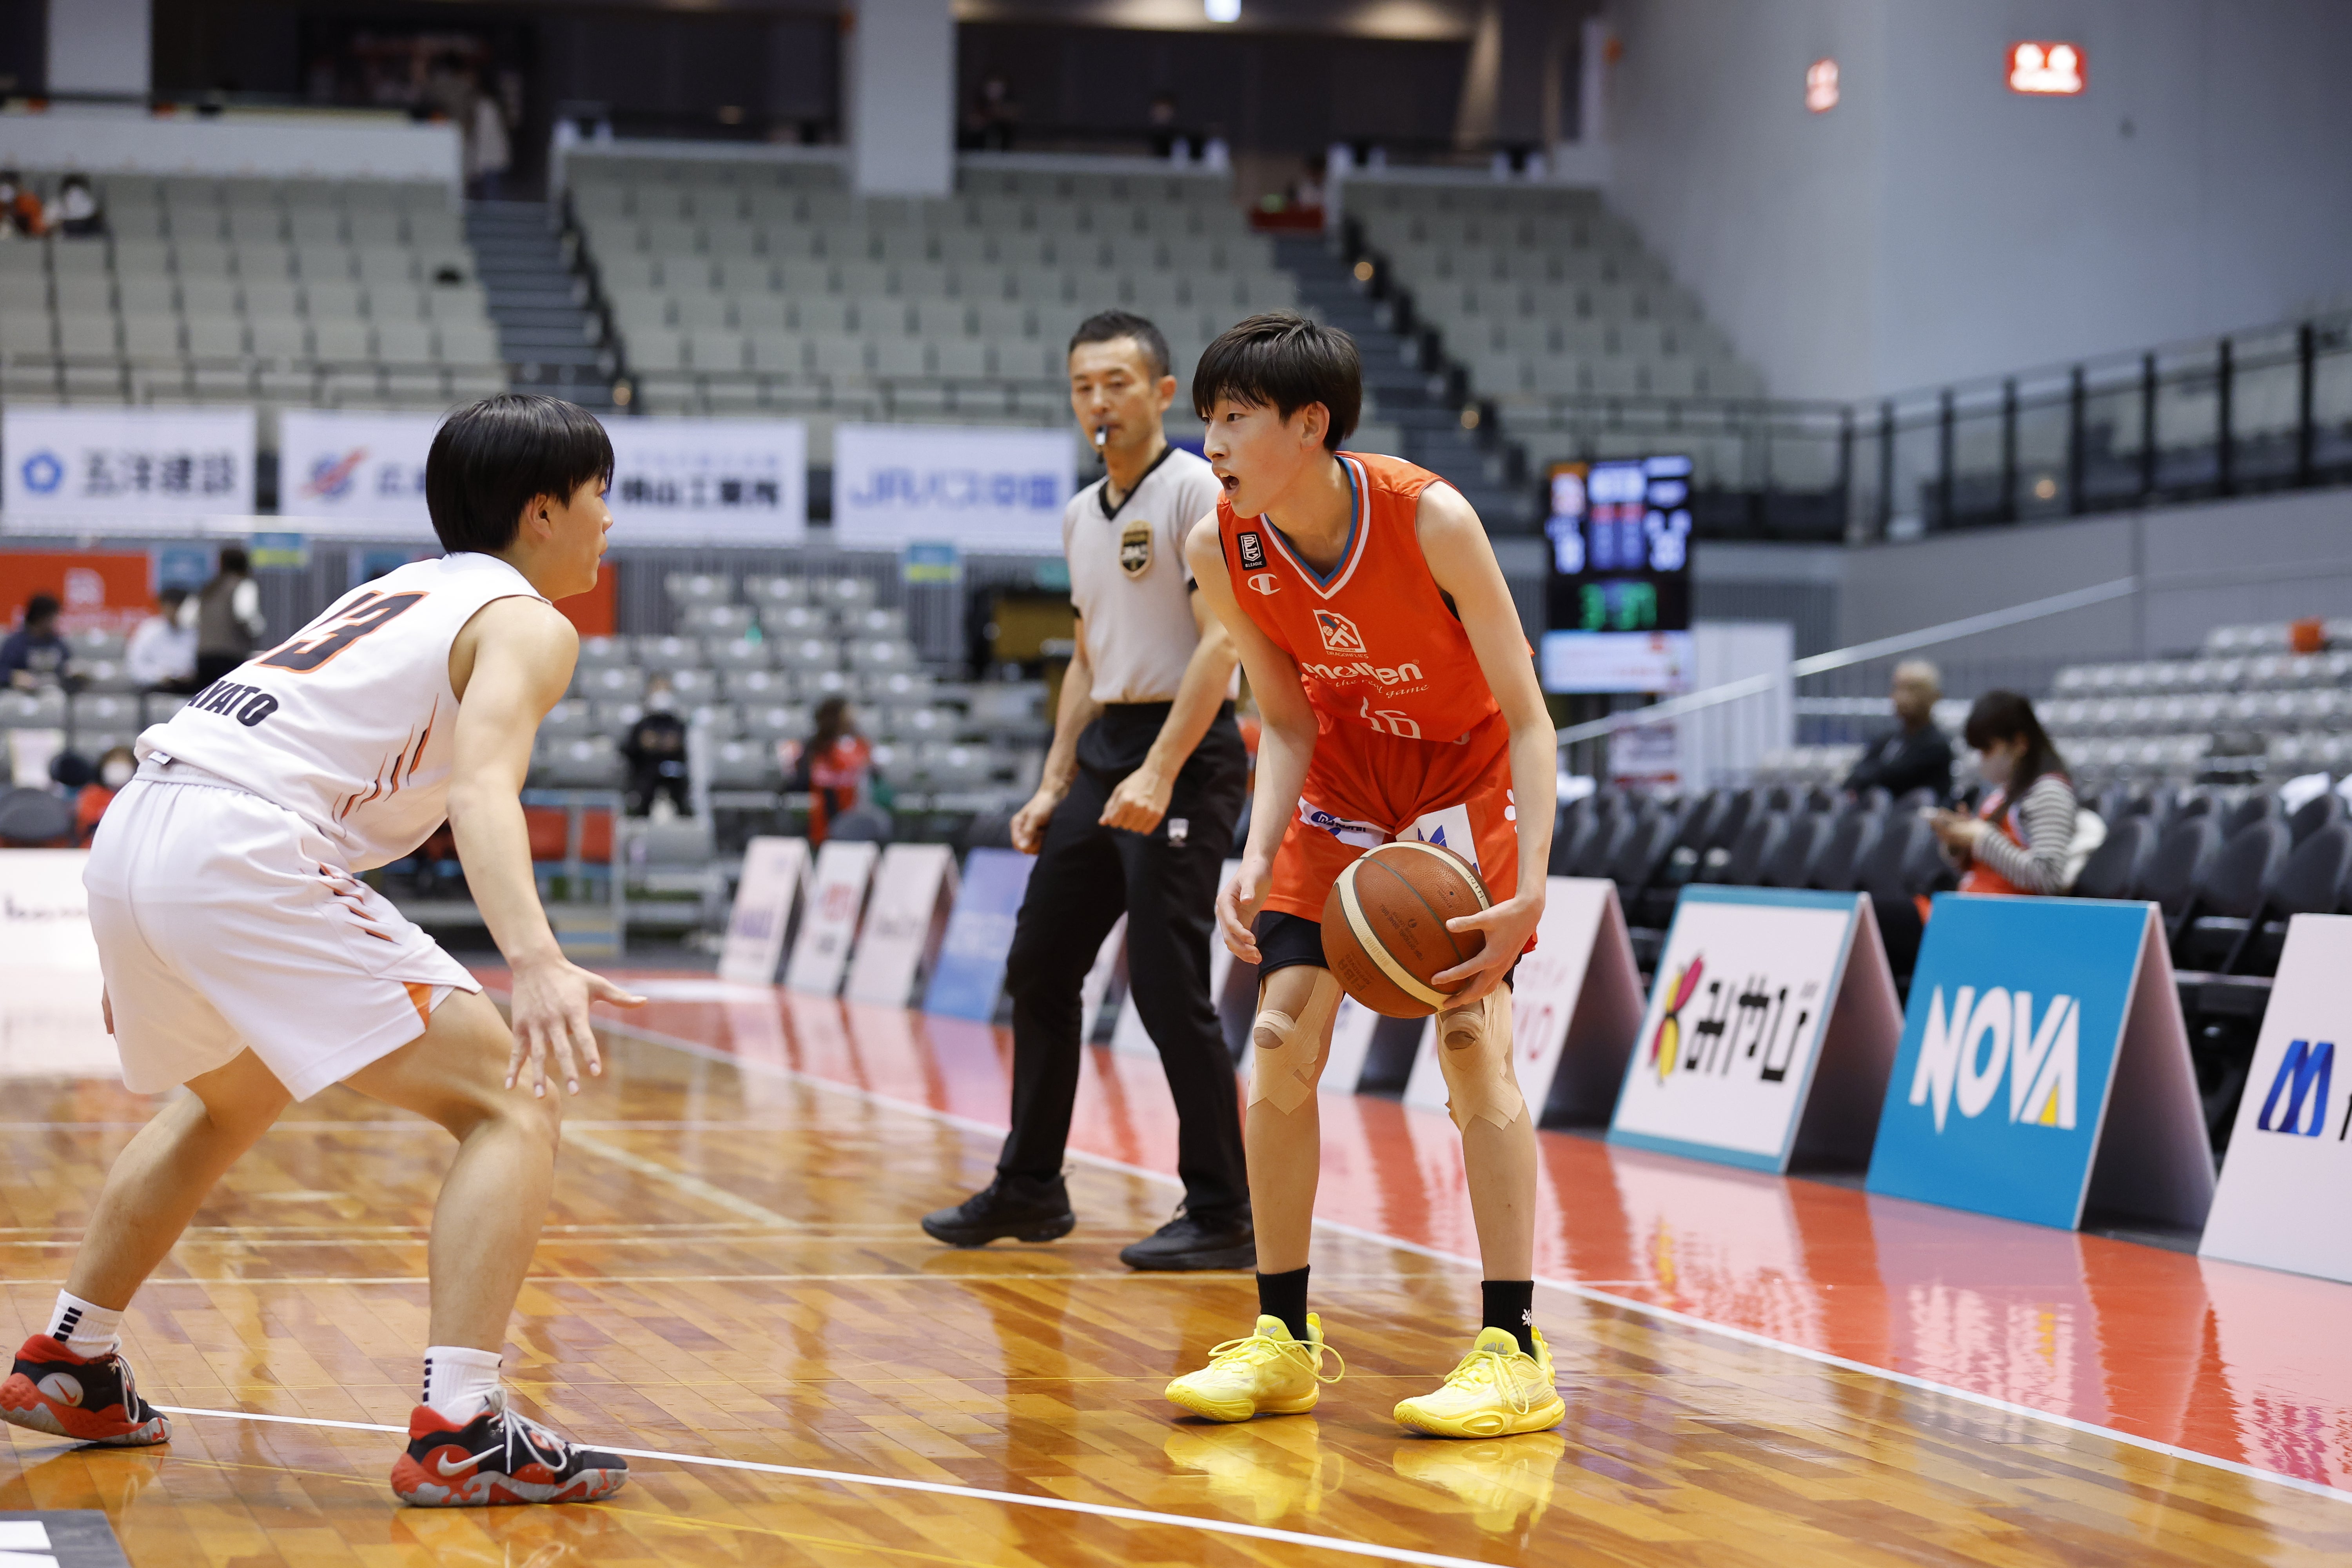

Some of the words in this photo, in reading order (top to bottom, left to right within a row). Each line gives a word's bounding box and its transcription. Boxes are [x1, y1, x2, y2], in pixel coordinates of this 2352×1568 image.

[253, 590, 431, 674] 13
[1326, 650, 1369, 659] DRAGONFLIES
[1302, 662, 1423, 685] molten
[1386, 684, 1430, 699] game
[1466, 873, 1484, 898] HIDE
[1338, 958, 1366, 992] FIBA
[1345, 954, 1372, 985] APPROVED
[1685, 974, 1819, 1082] みやび
[1908, 982, 2080, 1136] NOVA
